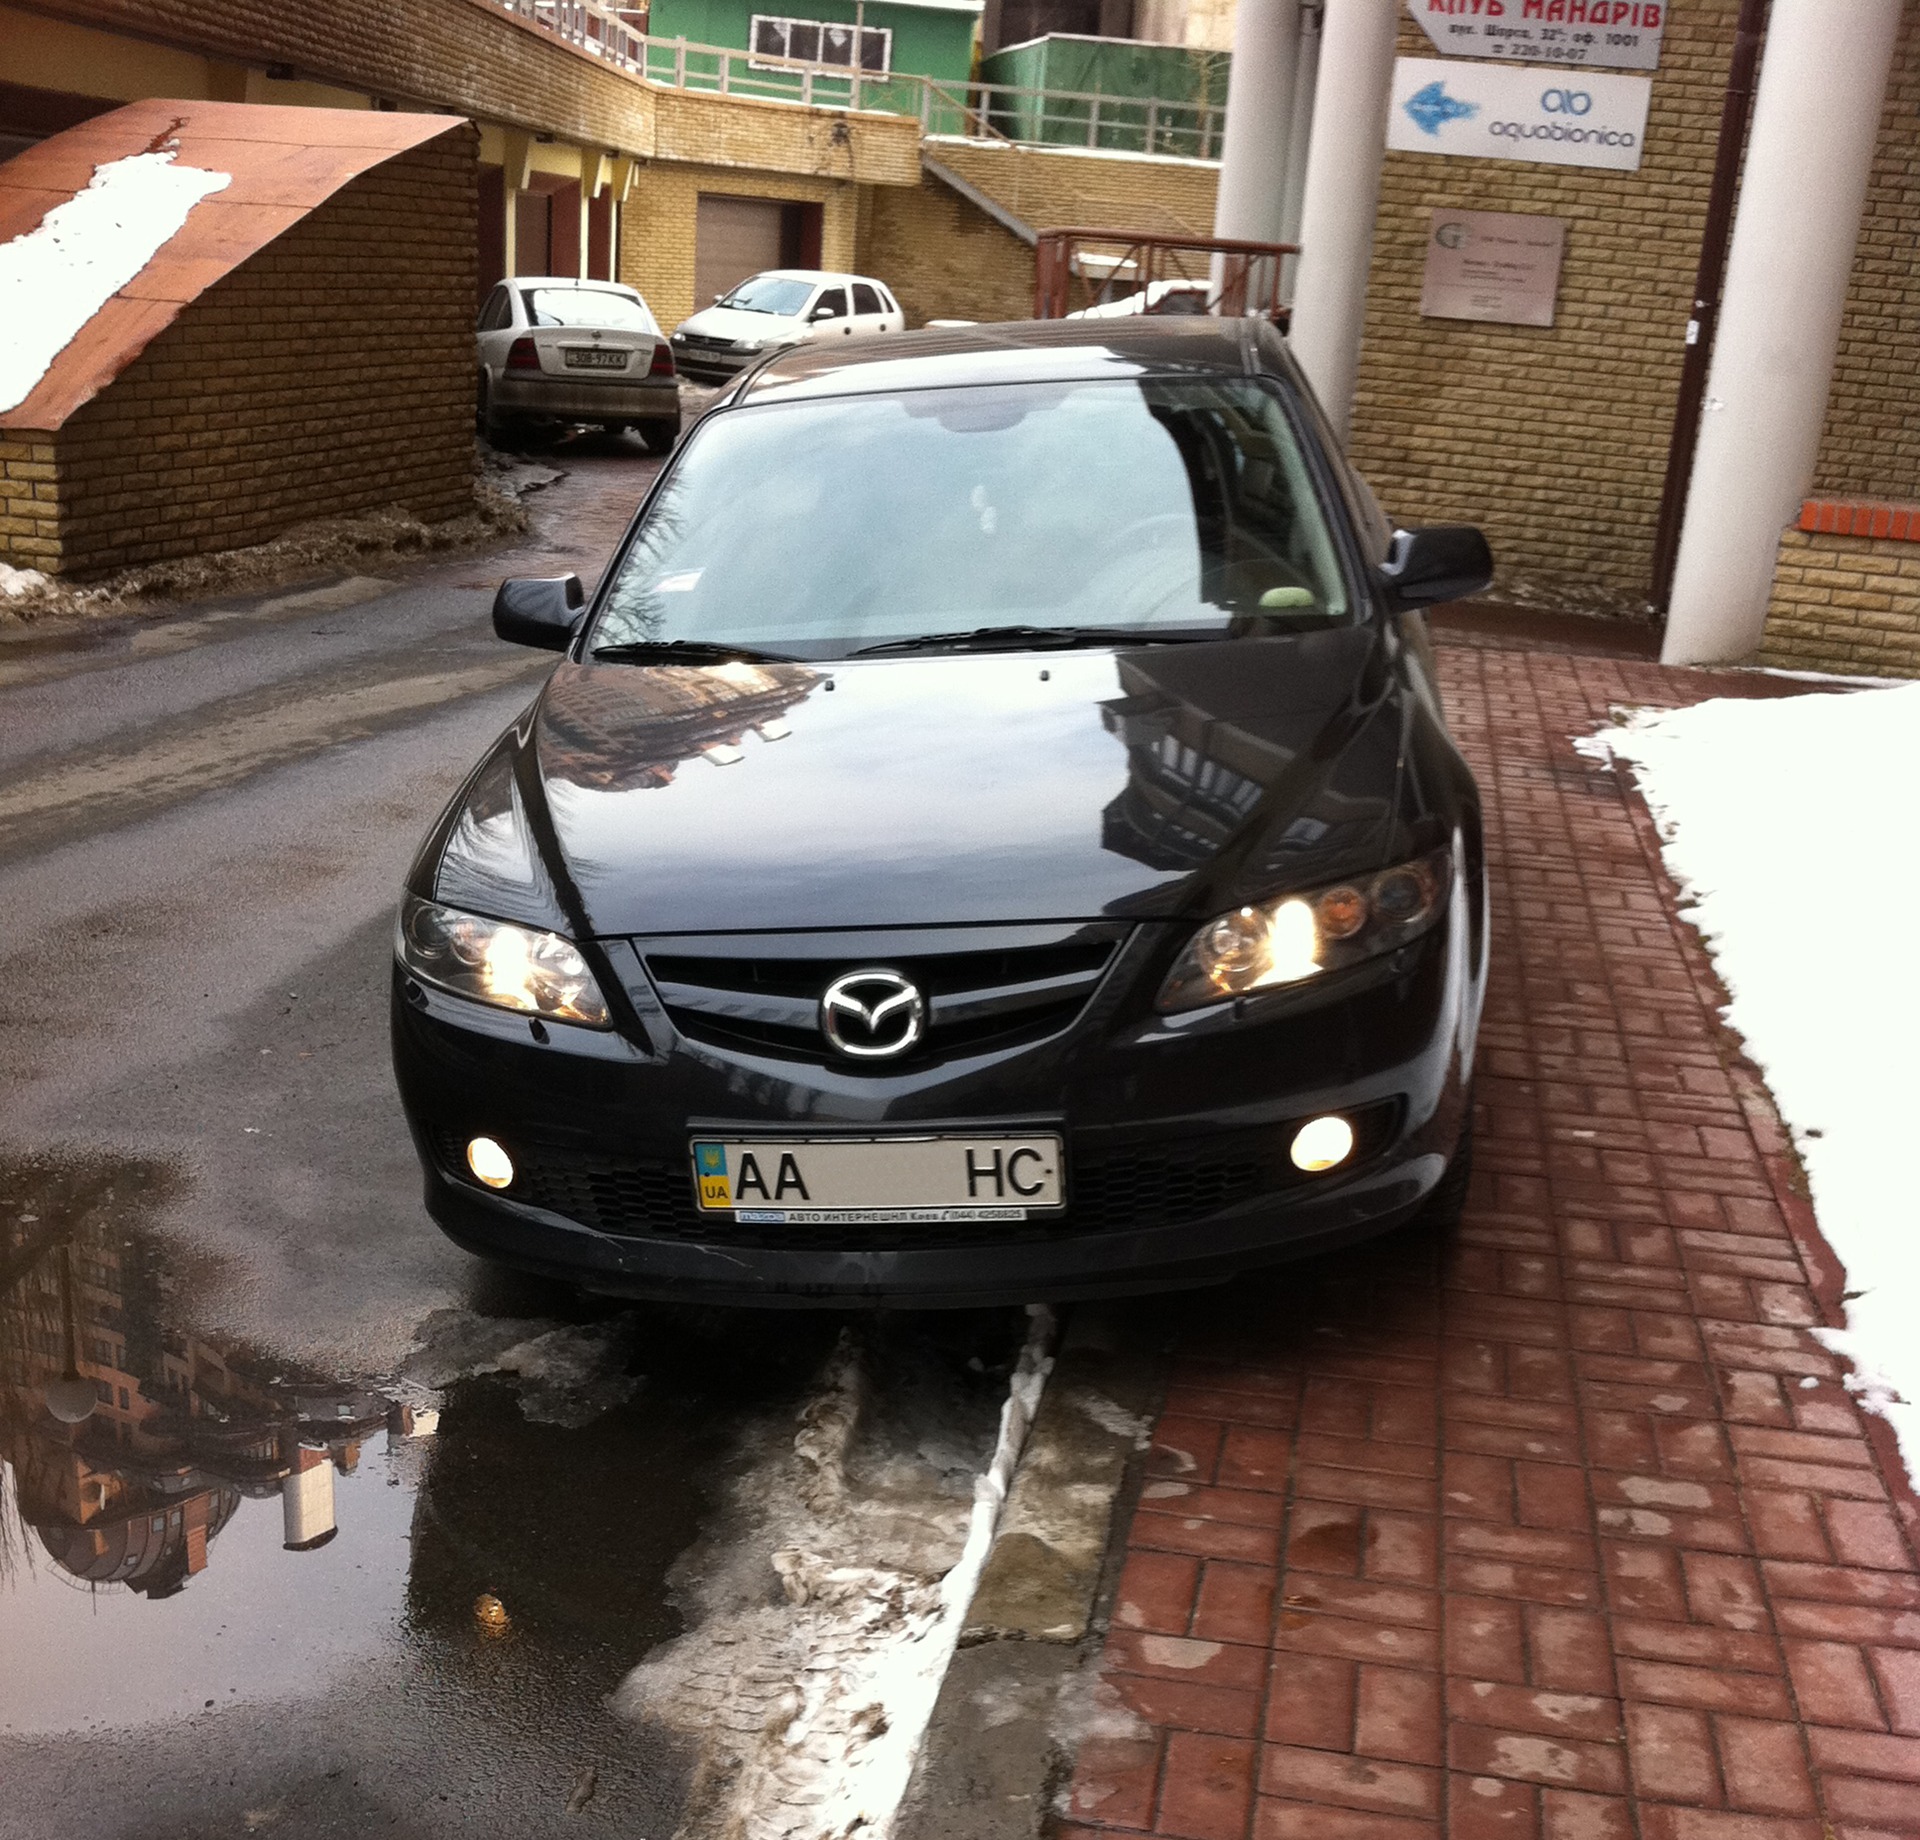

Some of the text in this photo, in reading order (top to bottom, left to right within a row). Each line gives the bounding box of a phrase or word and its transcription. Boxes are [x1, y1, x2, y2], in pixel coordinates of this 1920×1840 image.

[1488, 120, 1636, 147] aquabionica
[735, 1147, 1045, 1200] AA HC
[705, 1186, 728, 1199] UA
[788, 1213, 821, 1222] АВТО
